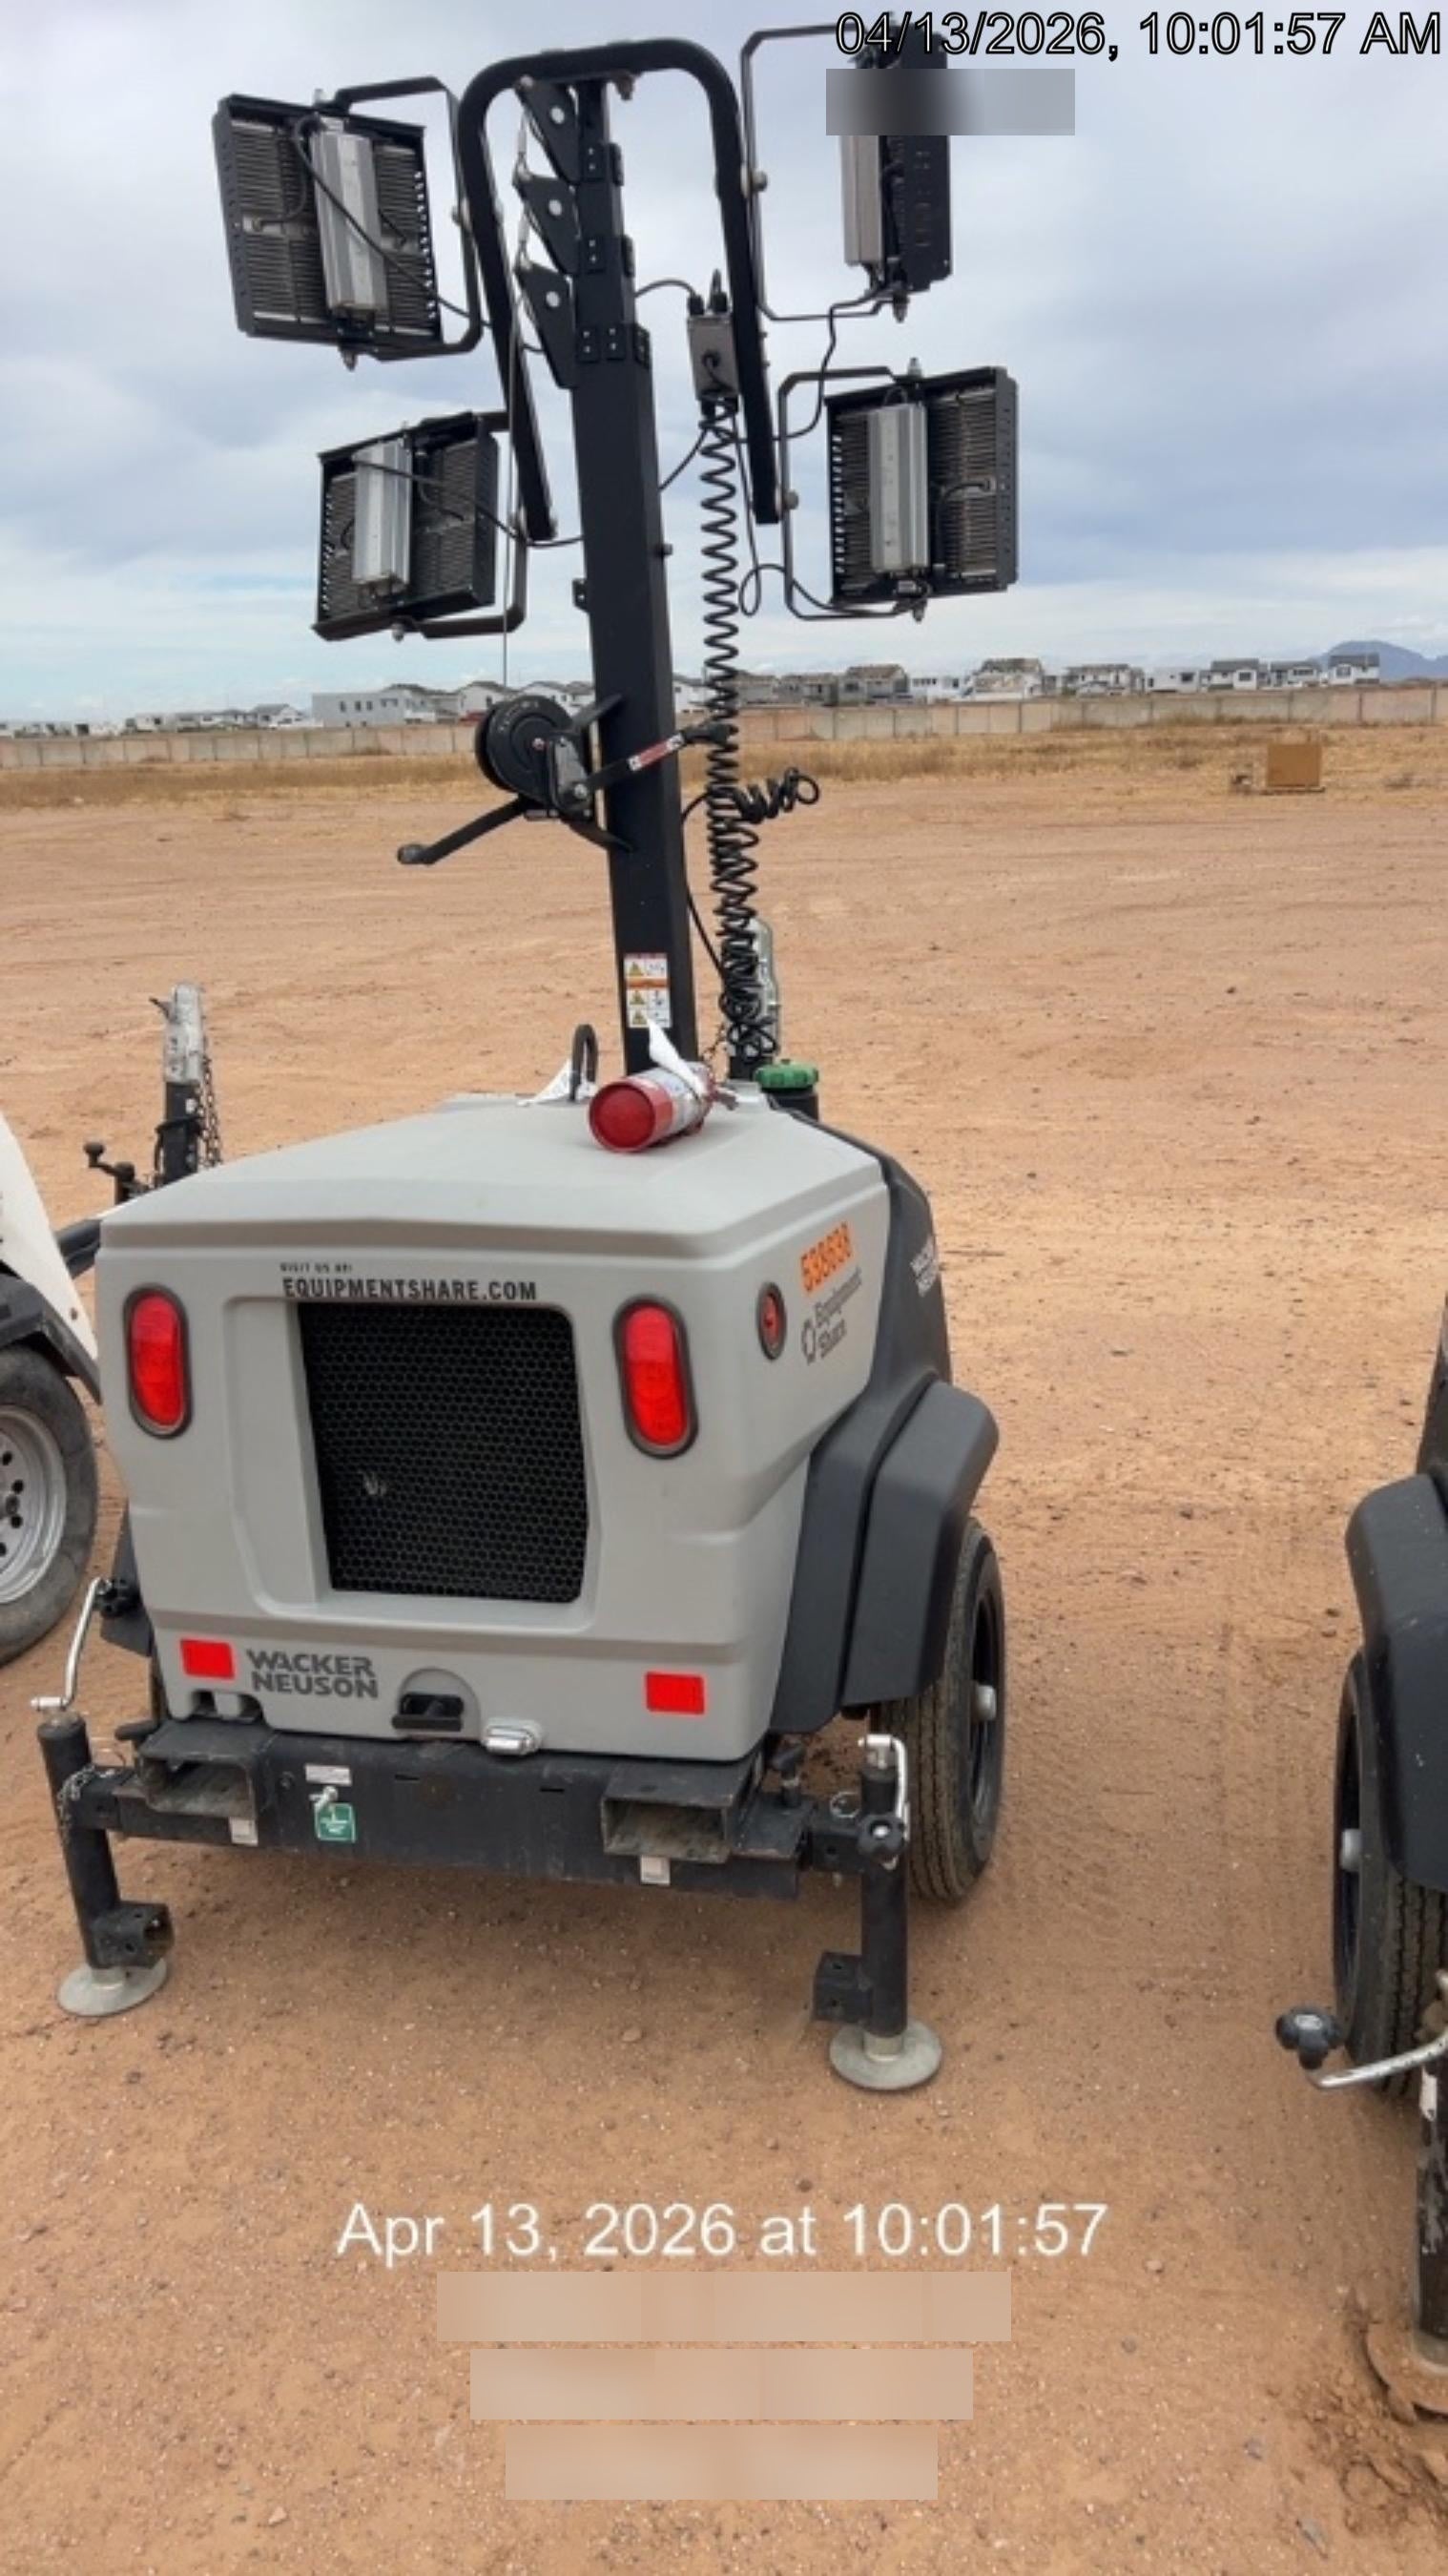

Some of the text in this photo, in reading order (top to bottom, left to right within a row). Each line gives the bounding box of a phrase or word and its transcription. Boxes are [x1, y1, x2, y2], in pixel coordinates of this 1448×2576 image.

[281, 1277, 538, 1300] EQUIPMENTSHARE.COM
[247, 1650, 376, 1678] WACKER
[251, 1672, 379, 1699] NEUSON
